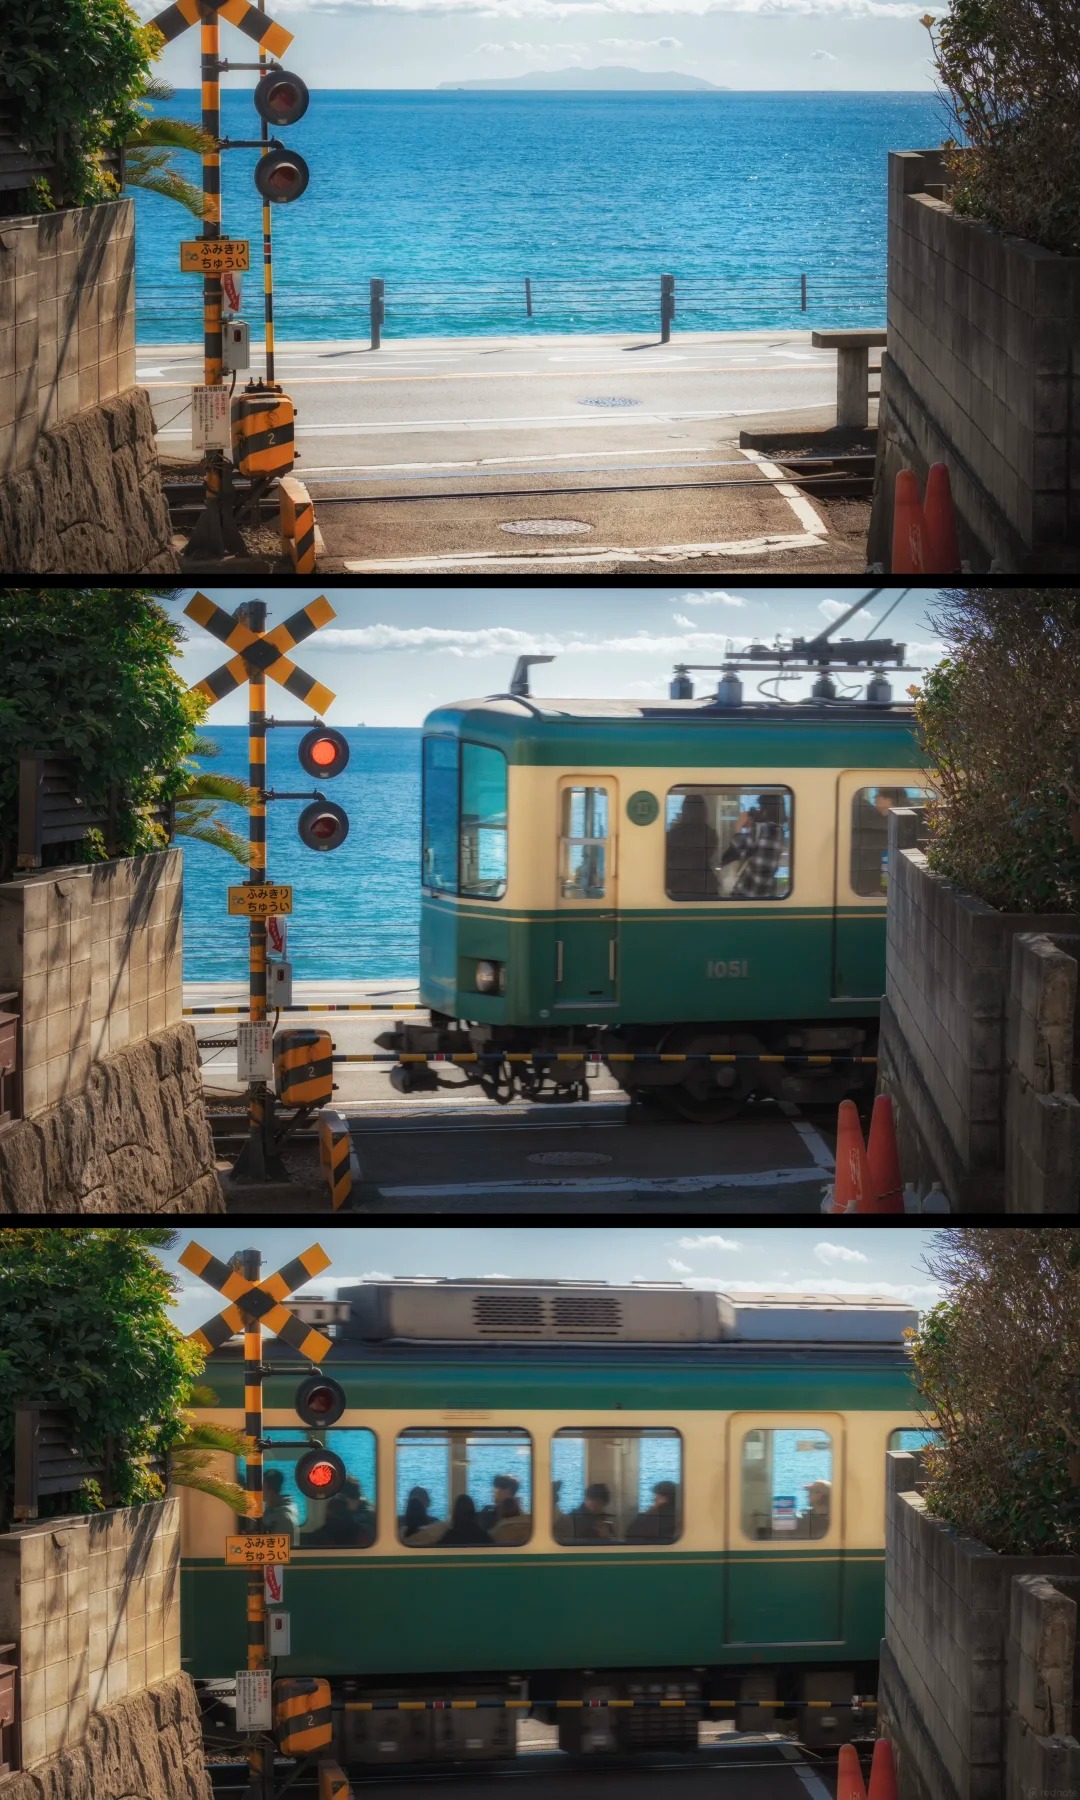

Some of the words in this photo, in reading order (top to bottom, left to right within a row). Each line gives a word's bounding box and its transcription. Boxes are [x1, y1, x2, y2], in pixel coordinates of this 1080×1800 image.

[201, 243, 246, 255] ふみきり
[201, 257, 247, 269] ちゅうい
[268, 432, 276, 445] 2
[247, 888, 289, 900] ふみきり
[247, 901, 290, 913] ちゅうい
[706, 960, 749, 979] 1051
[308, 1066, 316, 1077] 2
[244, 1537, 286, 1549] ふみきり
[244, 1550, 287, 1562] ちゅうい
[307, 1714, 315, 1726] 2
